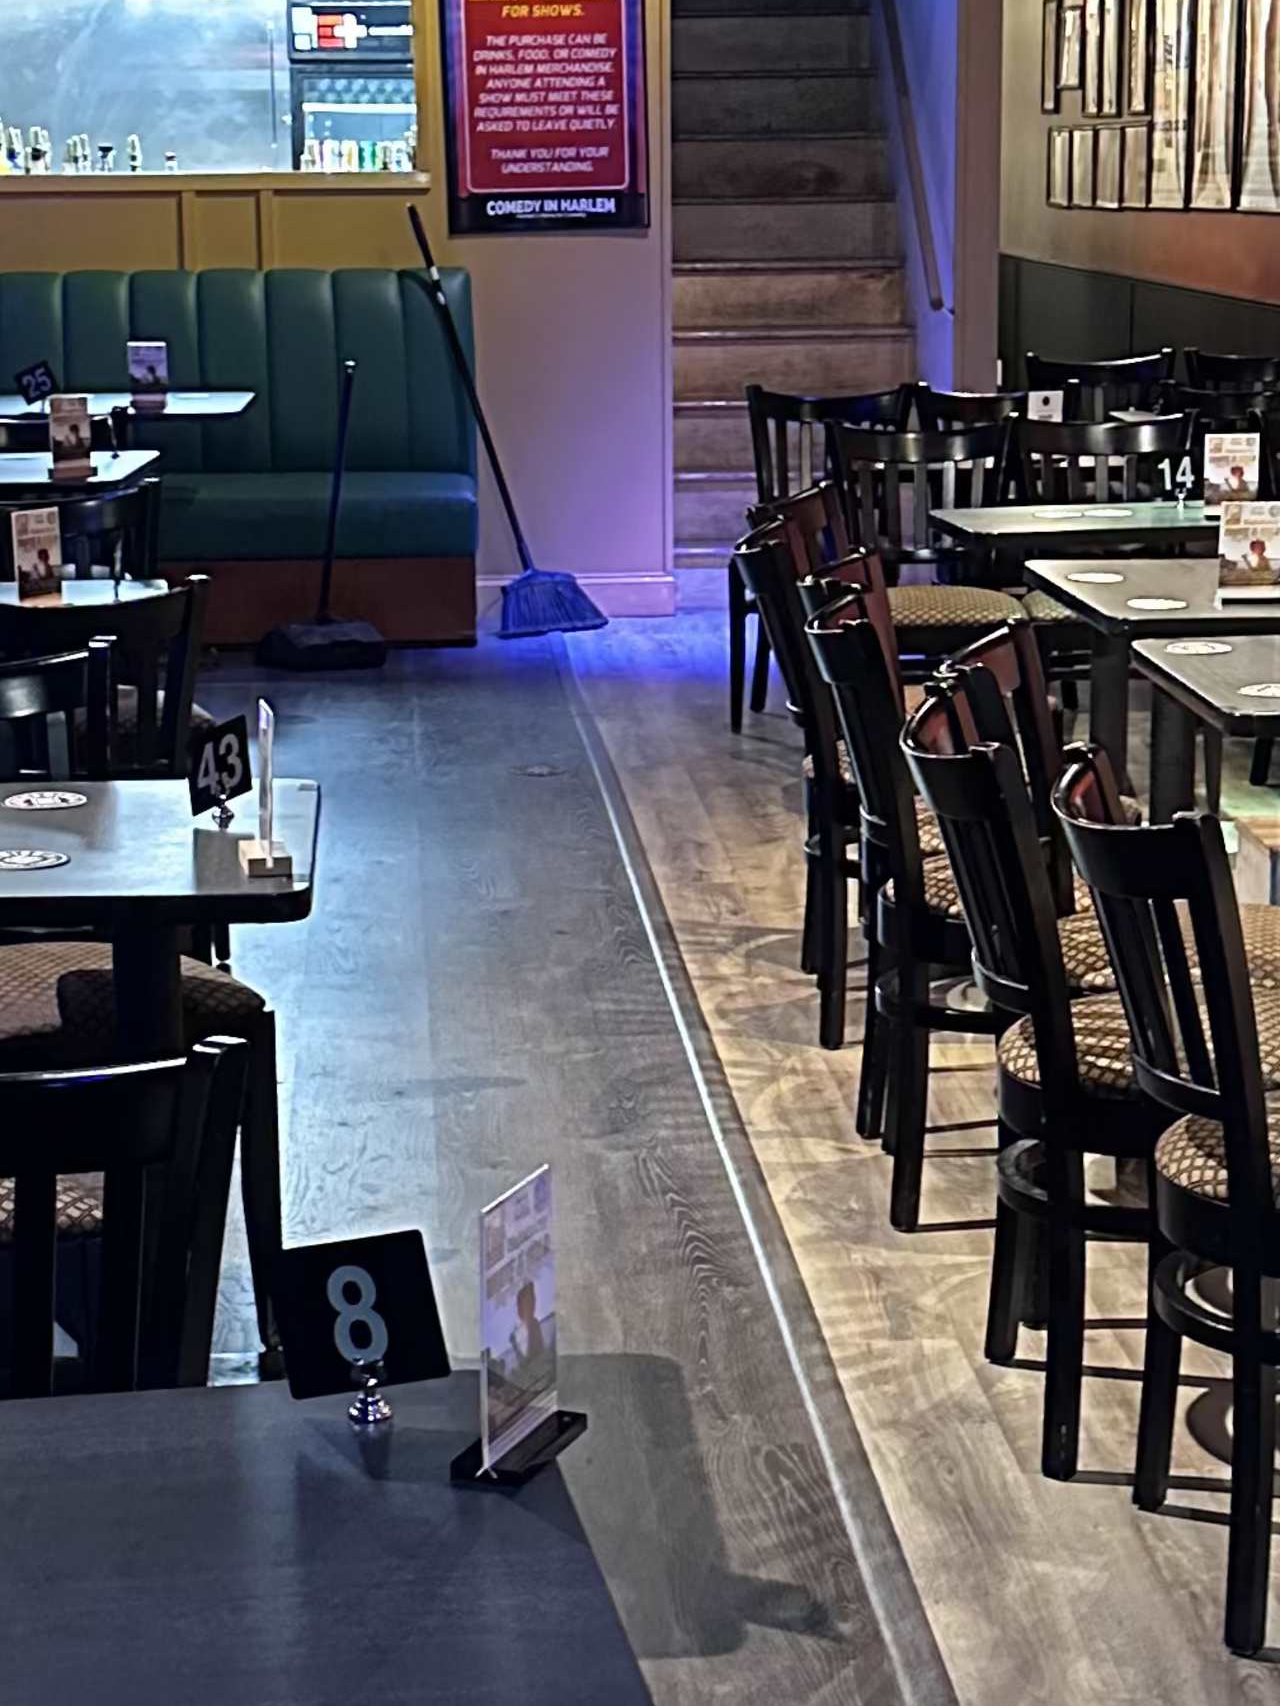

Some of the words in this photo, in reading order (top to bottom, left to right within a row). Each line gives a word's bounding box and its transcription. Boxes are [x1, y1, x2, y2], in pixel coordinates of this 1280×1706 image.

[501, 4, 530, 18] FOR
[531, 3, 585, 18] SHOWS.
[486, 35, 508, 46] THE
[508, 34, 566, 46] PURCHASE
[567, 33, 593, 45] CAN
[593, 33, 608, 44] BE
[475, 64, 488, 76] IN
[488, 63, 535, 75] HARLEM
[485, 78, 533, 90] ANYONE
[533, 77, 595, 88] ATTENDING
[596, 76, 607, 87] A
[478, 93, 513, 105] SHOW
[513, 92, 546, 103] MUST
[580, 90, 615, 102] THESE
[576, 104, 603, 116] WILL
[515, 120, 531, 131] TO
[531, 119, 567, 131] LEAVE
[490, 148, 528, 160] THANK
[554, 147, 578, 158] FOR
[578, 146, 610, 157] YOUR
[486, 198, 542, 216] COMEDY
[543, 198, 559, 213] IN
[560, 197, 617, 214] HARLEM
[21, 366, 52, 399] 25
[1157, 455, 1196, 491] 14
[196, 733, 243, 796] 43
[326, 1264, 389, 1366] 8
